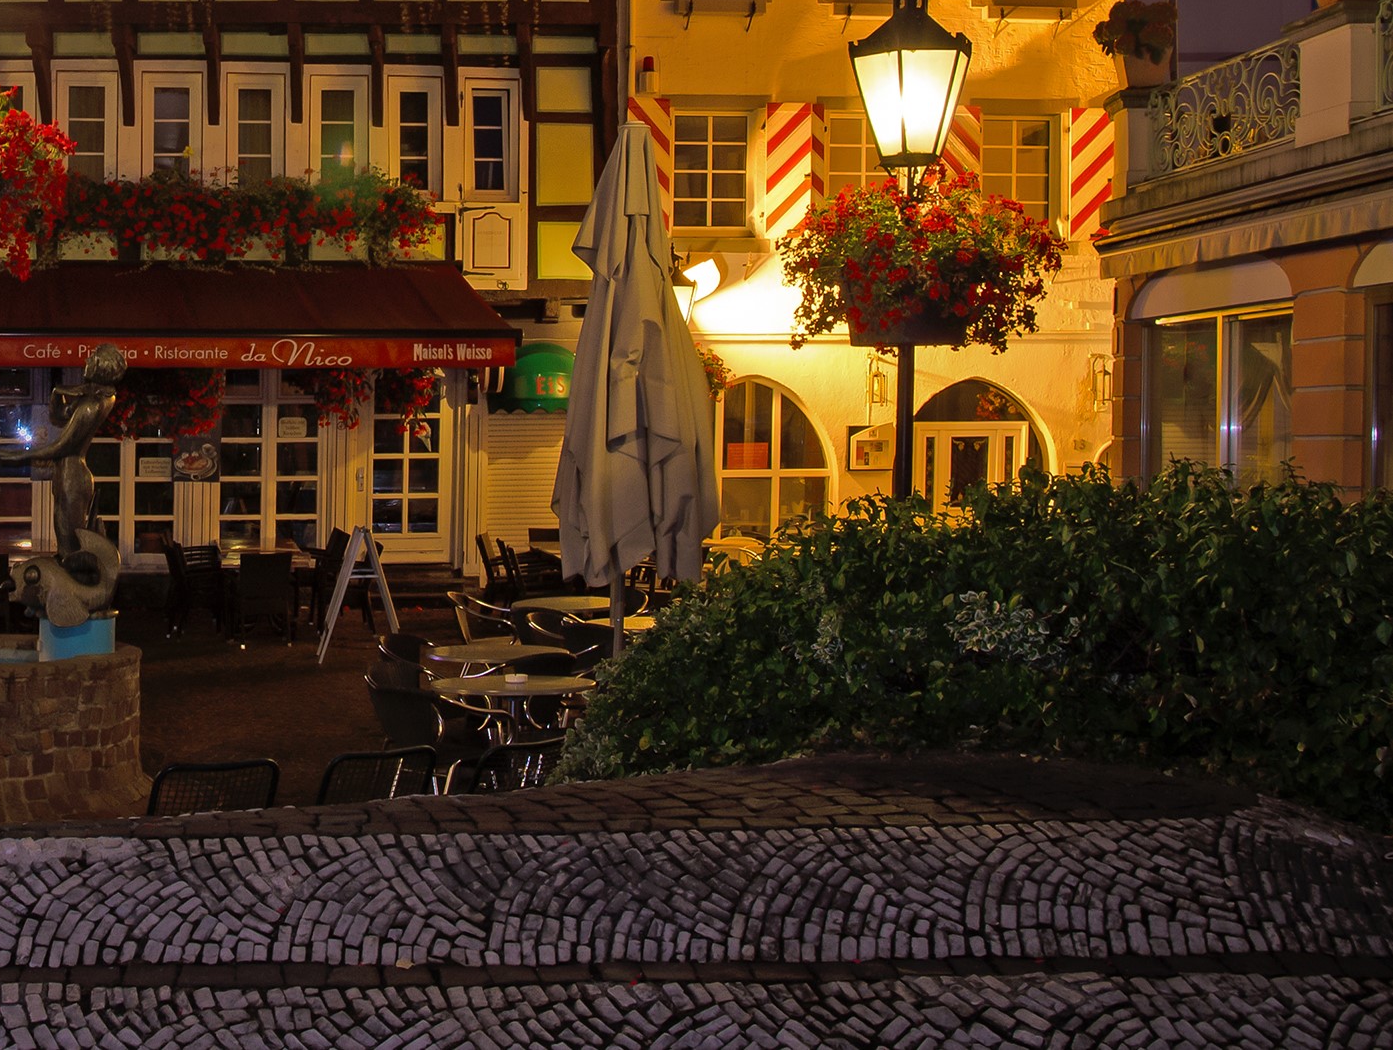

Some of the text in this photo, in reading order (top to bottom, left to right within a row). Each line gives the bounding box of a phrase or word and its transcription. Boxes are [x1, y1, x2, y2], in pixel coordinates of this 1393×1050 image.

[23, 338, 353, 366] Café Piia Ristorante da Nico
[413, 343, 493, 362] Maisel's Weisse
